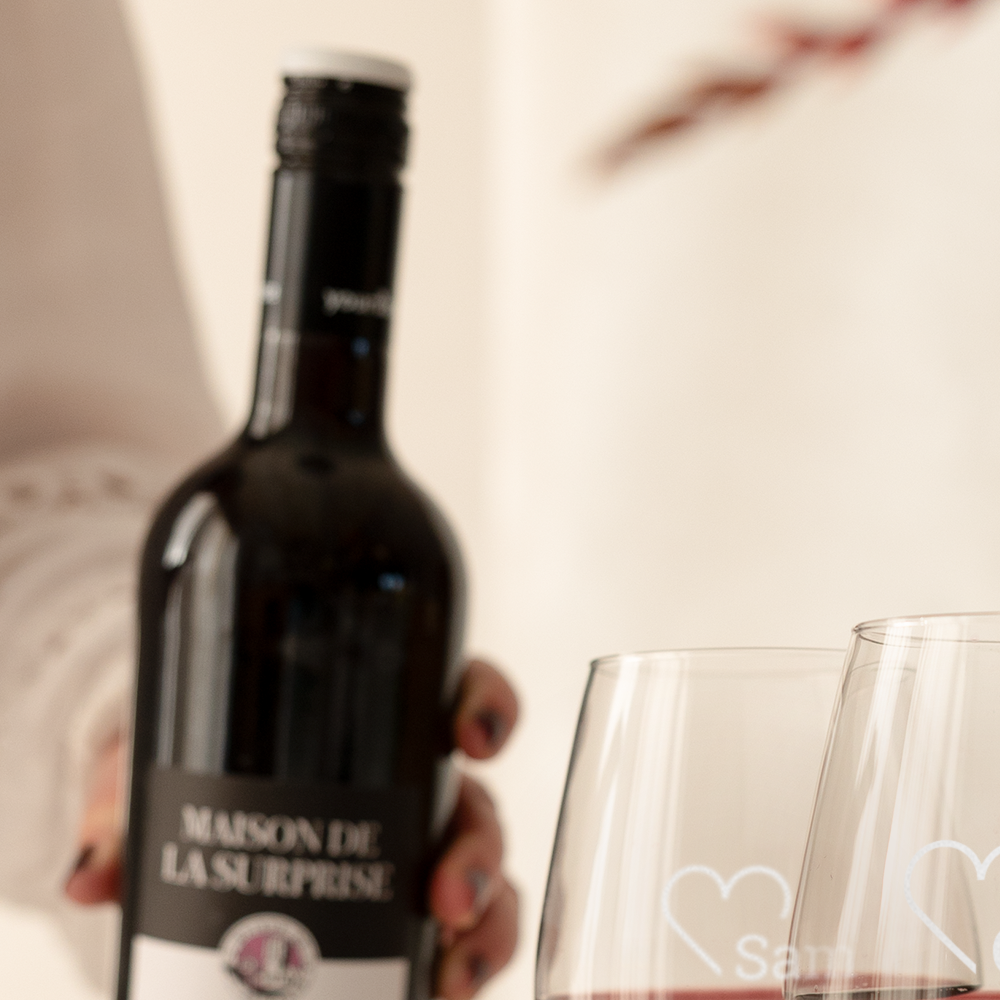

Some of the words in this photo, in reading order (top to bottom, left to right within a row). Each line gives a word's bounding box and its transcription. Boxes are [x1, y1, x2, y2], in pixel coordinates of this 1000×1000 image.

[181, 803, 324, 853] MAISON
[326, 818, 383, 858] DE
[160, 841, 209, 889] LA
[210, 849, 395, 901] SURPRISE
[735, 933, 855, 980] Sam
